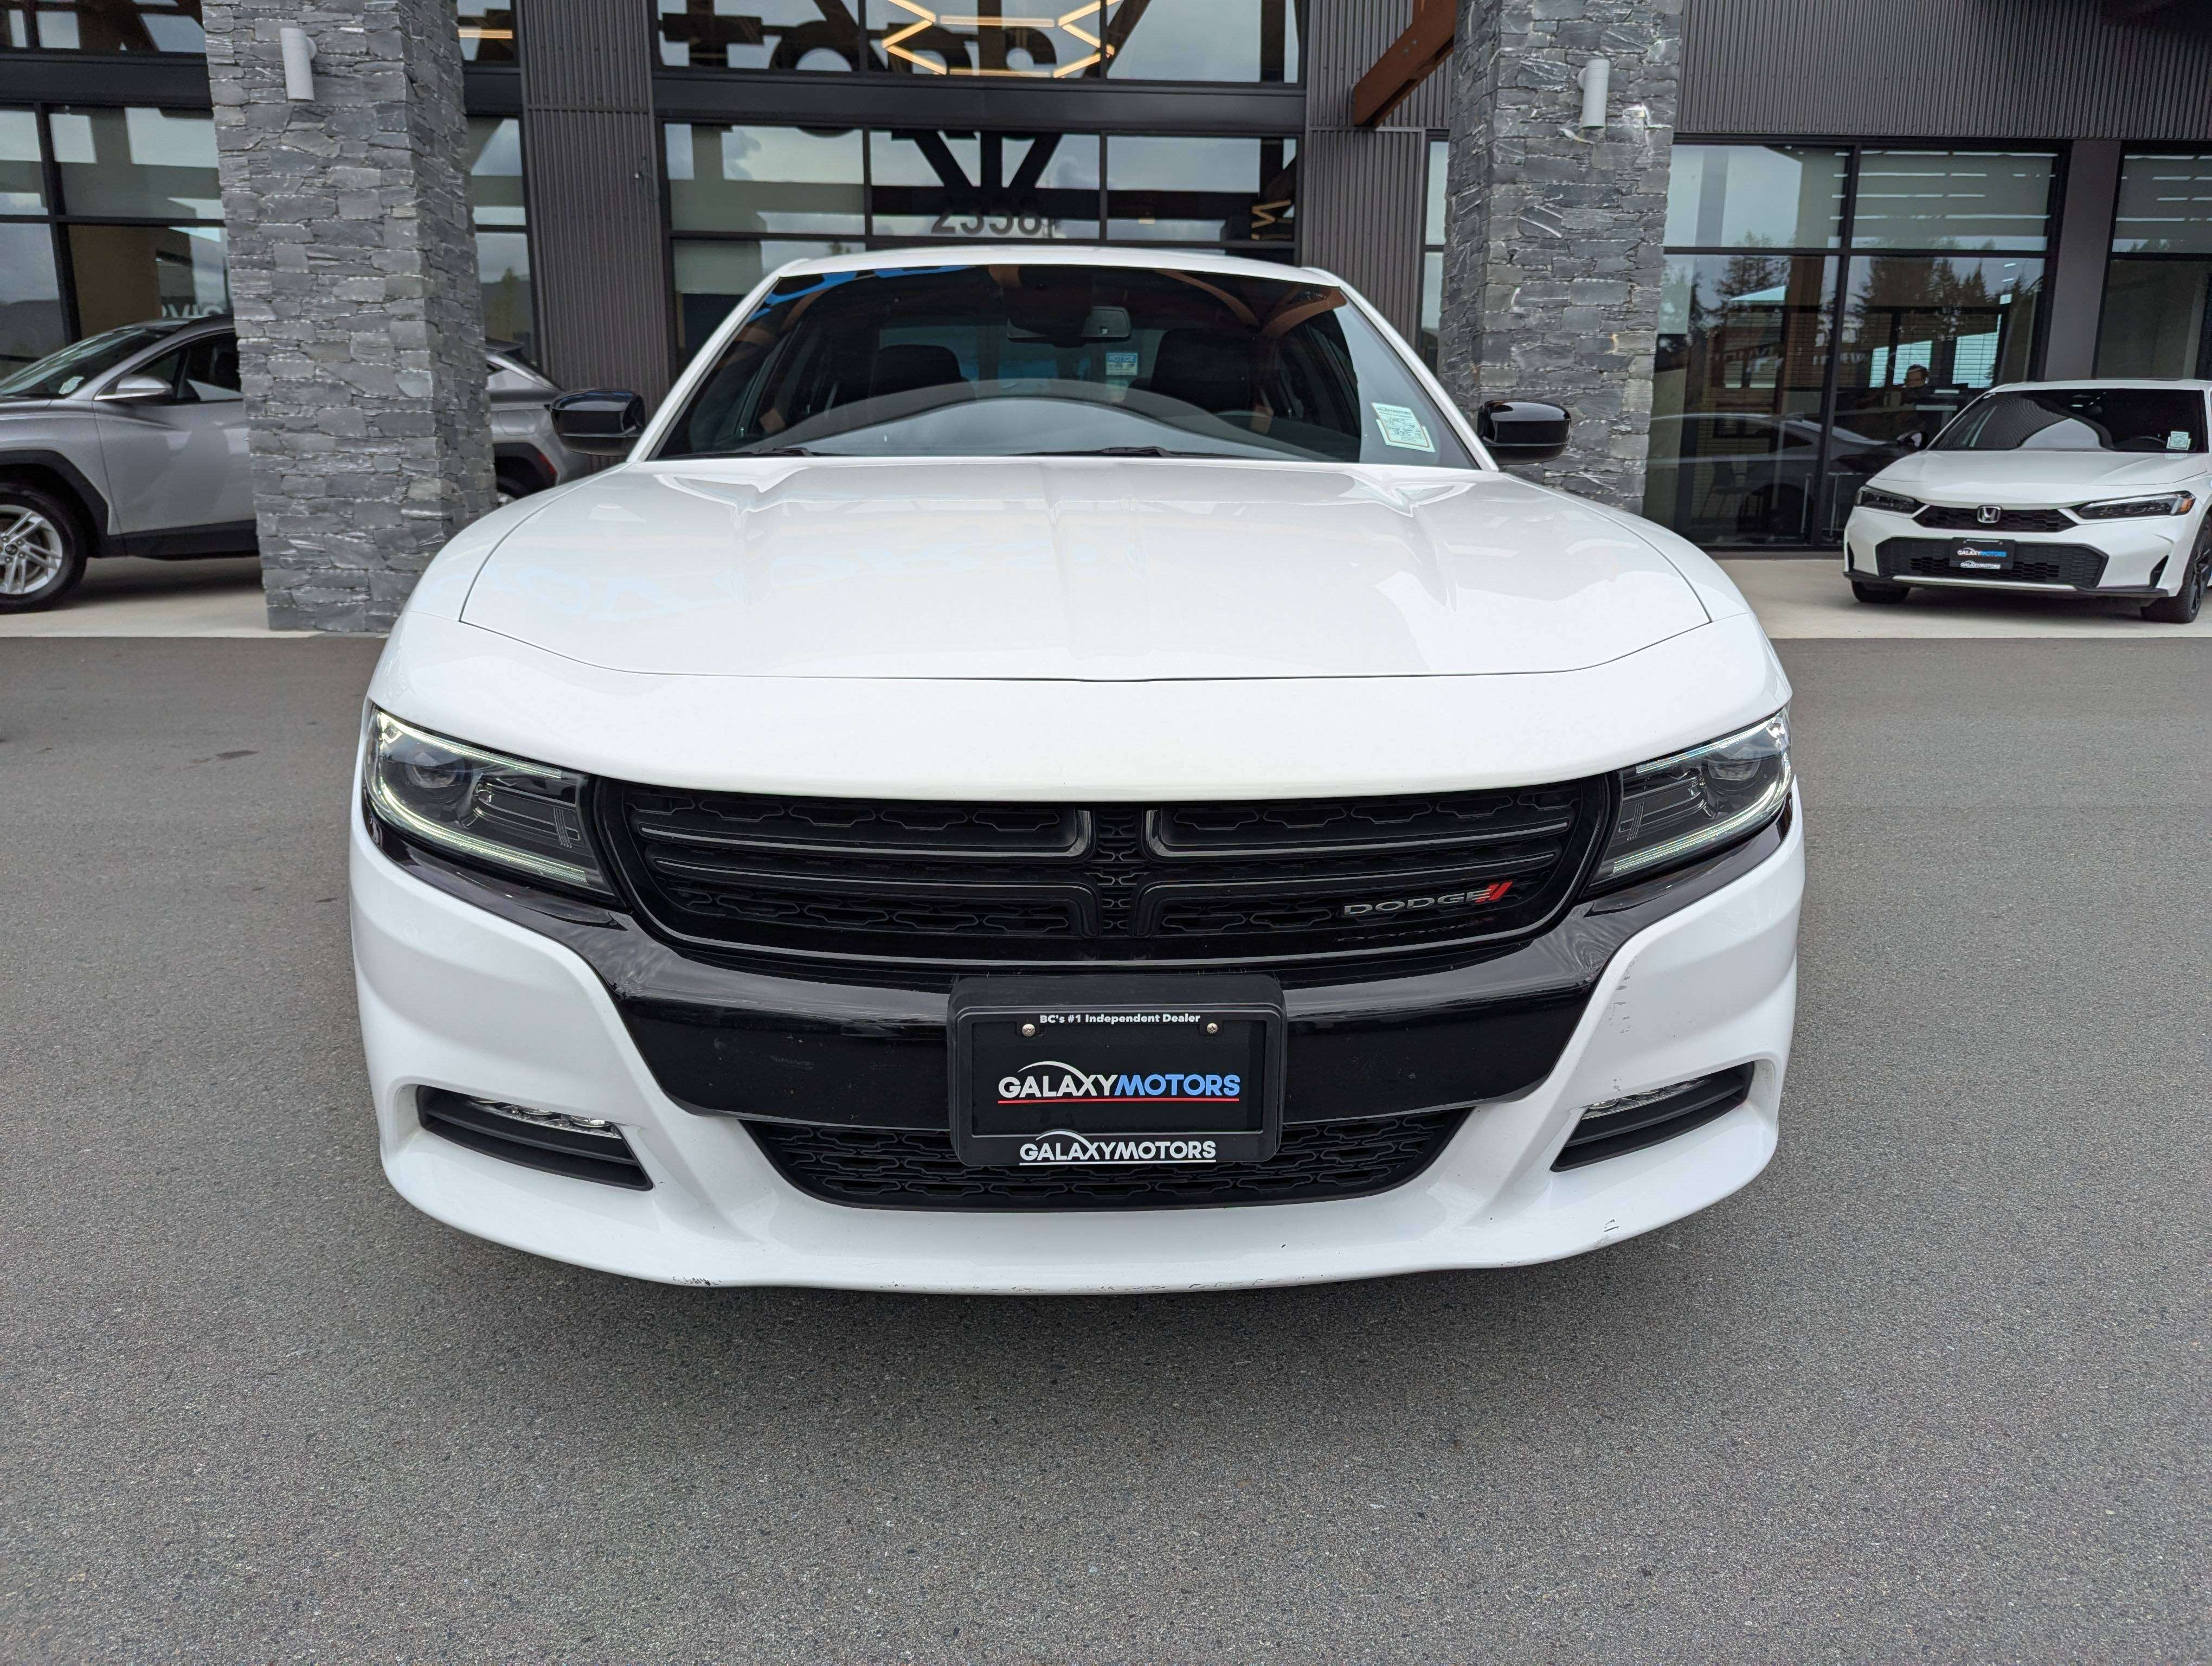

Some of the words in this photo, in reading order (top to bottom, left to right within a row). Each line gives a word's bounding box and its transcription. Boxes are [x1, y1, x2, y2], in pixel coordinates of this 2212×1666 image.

[1344, 888, 1492, 916] DODGE
[1039, 1014, 1065, 1023] BC's
[1068, 1014, 1081, 1023] #1
[1085, 1014, 1160, 1024] Independent
[1162, 1013, 1201, 1022] Dealer
